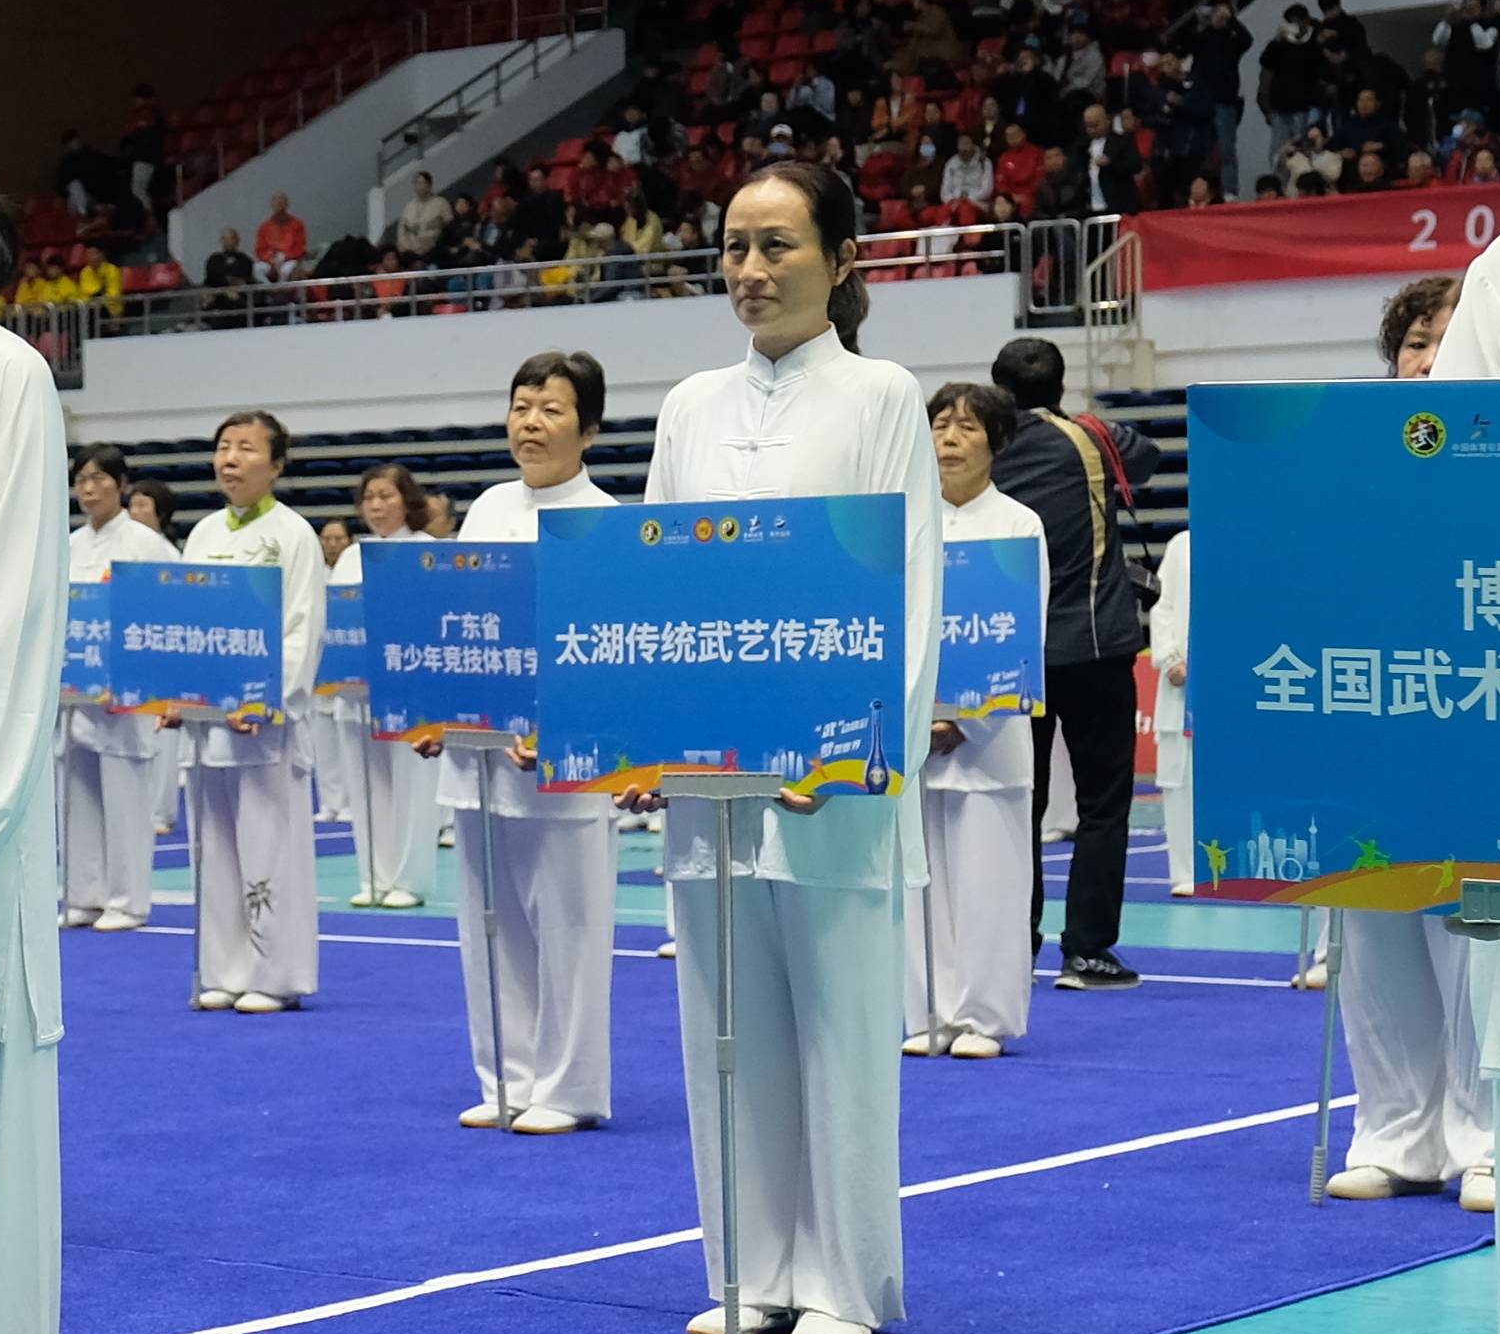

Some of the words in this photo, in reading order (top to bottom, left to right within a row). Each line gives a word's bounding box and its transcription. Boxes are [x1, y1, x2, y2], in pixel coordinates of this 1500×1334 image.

[122, 622, 269, 660] 金坛武协代表队
[440, 611, 501, 641] 广东省
[554, 616, 885, 667] 太湖传统武艺传承站
